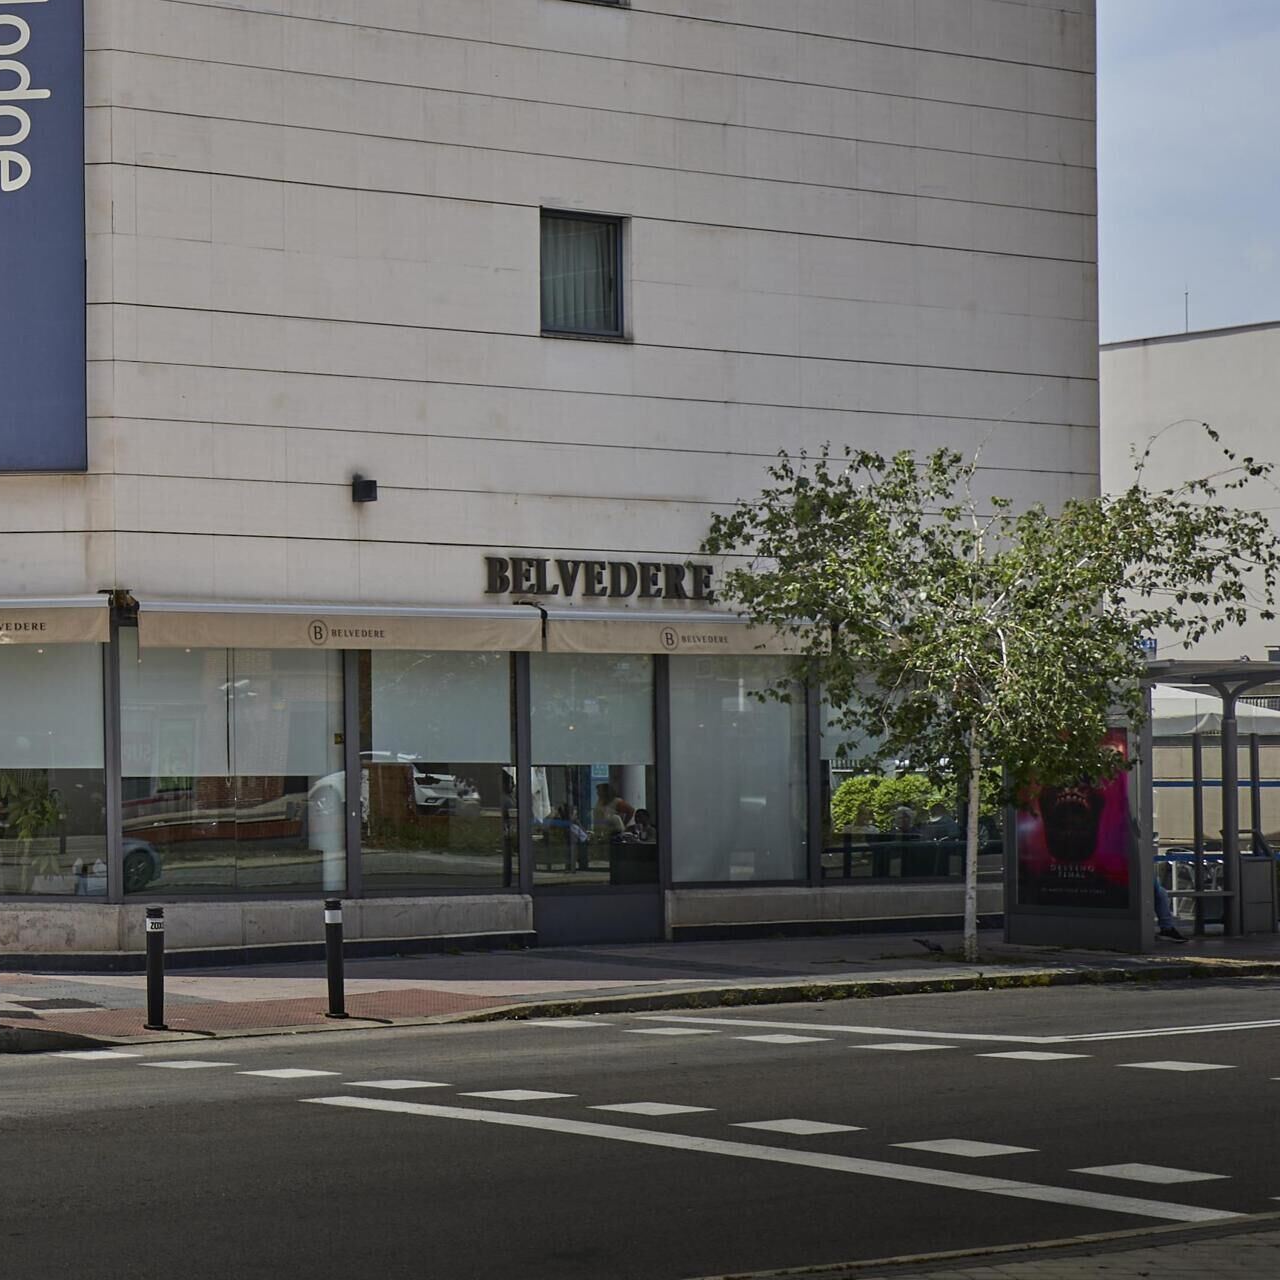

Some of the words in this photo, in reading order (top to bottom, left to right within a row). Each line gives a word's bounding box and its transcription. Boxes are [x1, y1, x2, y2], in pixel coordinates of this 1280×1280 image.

[484, 556, 717, 601] BELVEDERE
[331, 628, 385, 638] BELVEDERE
[681, 635, 728, 644] BELVEDERE
